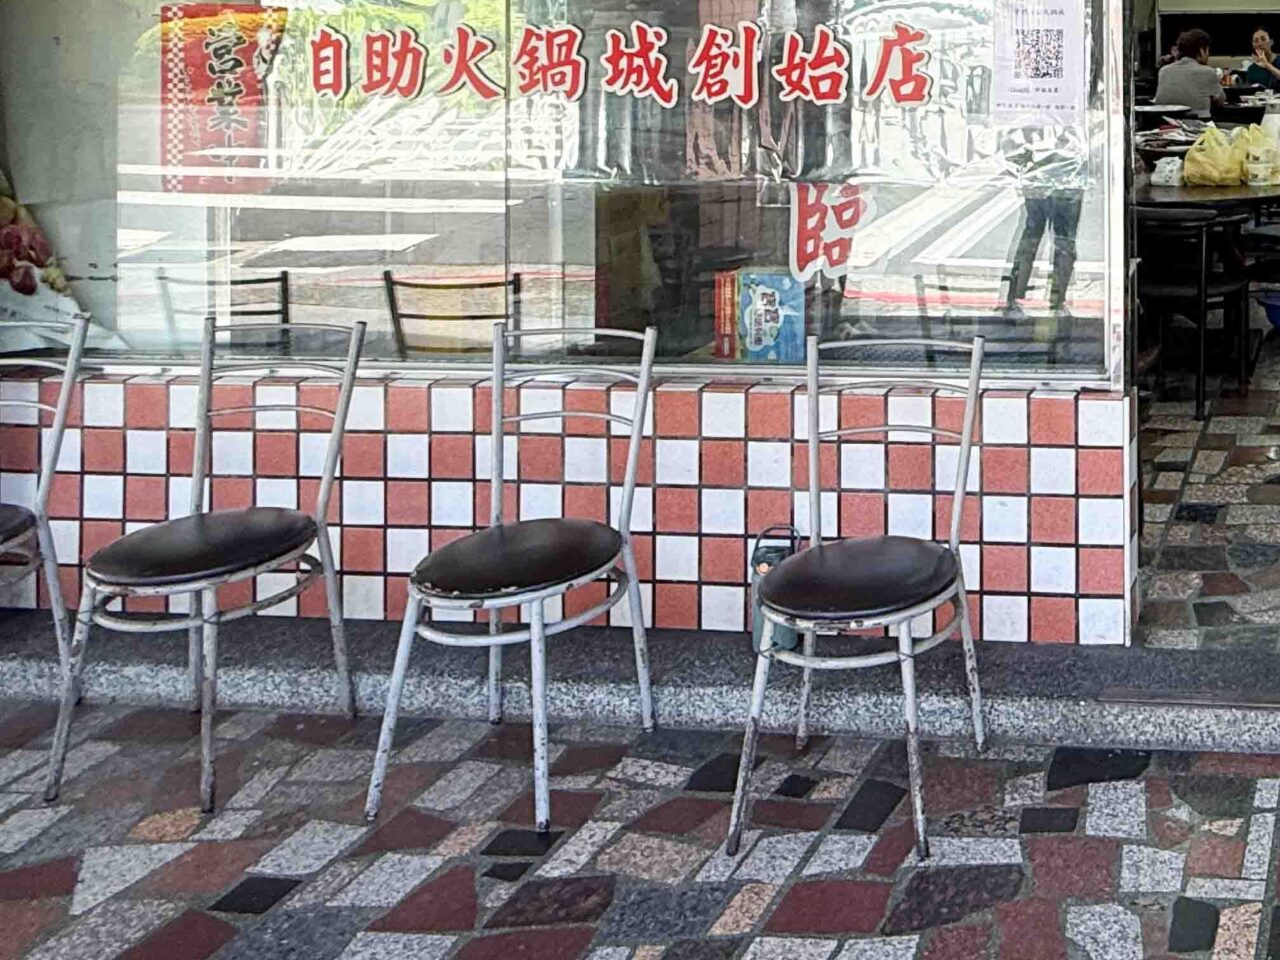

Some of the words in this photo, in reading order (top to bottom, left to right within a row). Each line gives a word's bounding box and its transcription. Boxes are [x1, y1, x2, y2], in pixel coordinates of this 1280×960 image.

[310, 22, 930, 108] 自助火鍋城創始店
